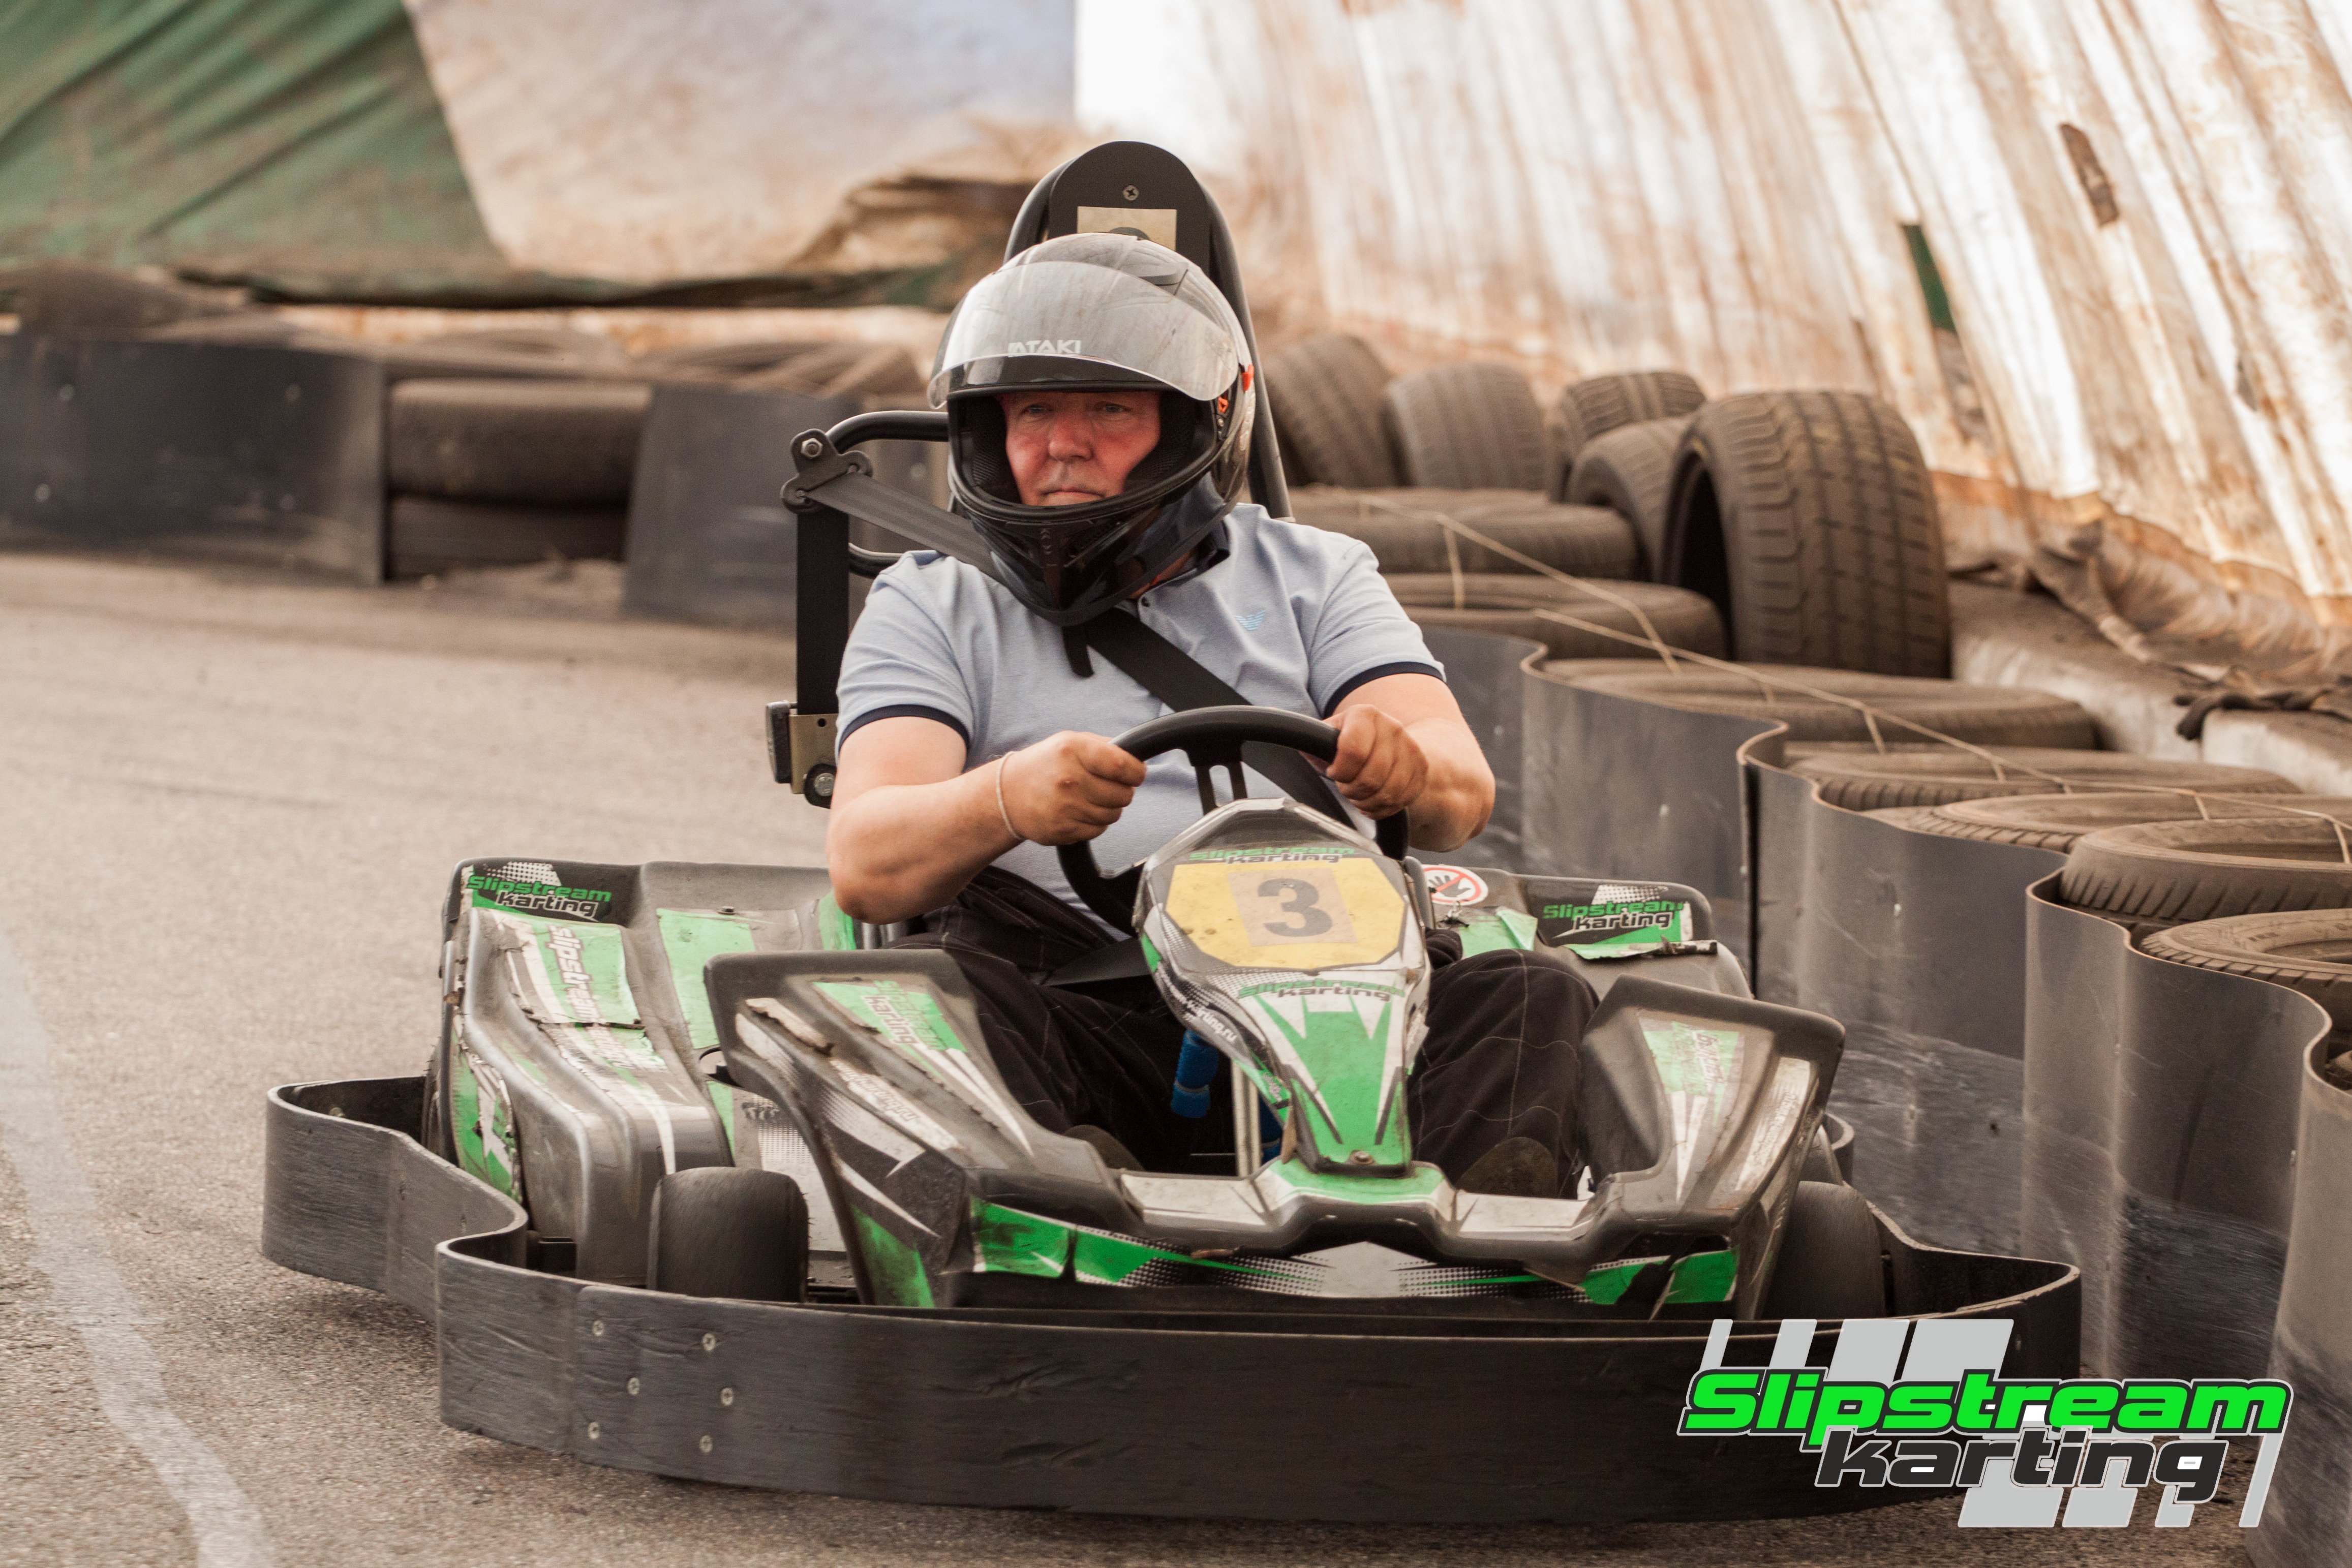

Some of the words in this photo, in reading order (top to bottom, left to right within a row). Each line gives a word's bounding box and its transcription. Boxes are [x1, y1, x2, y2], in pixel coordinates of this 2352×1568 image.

[1008, 340, 1081, 356] ATAKI
[1189, 847, 1356, 861] Slipstream
[1227, 853, 1342, 864] karting
[466, 876, 612, 902] Slipstream
[496, 890, 599, 917] karting
[1257, 878, 1333, 937] 3
[1575, 912, 1673, 929] karting
[1277, 987, 1391, 1002] karting
[862, 995, 919, 1044] karting
